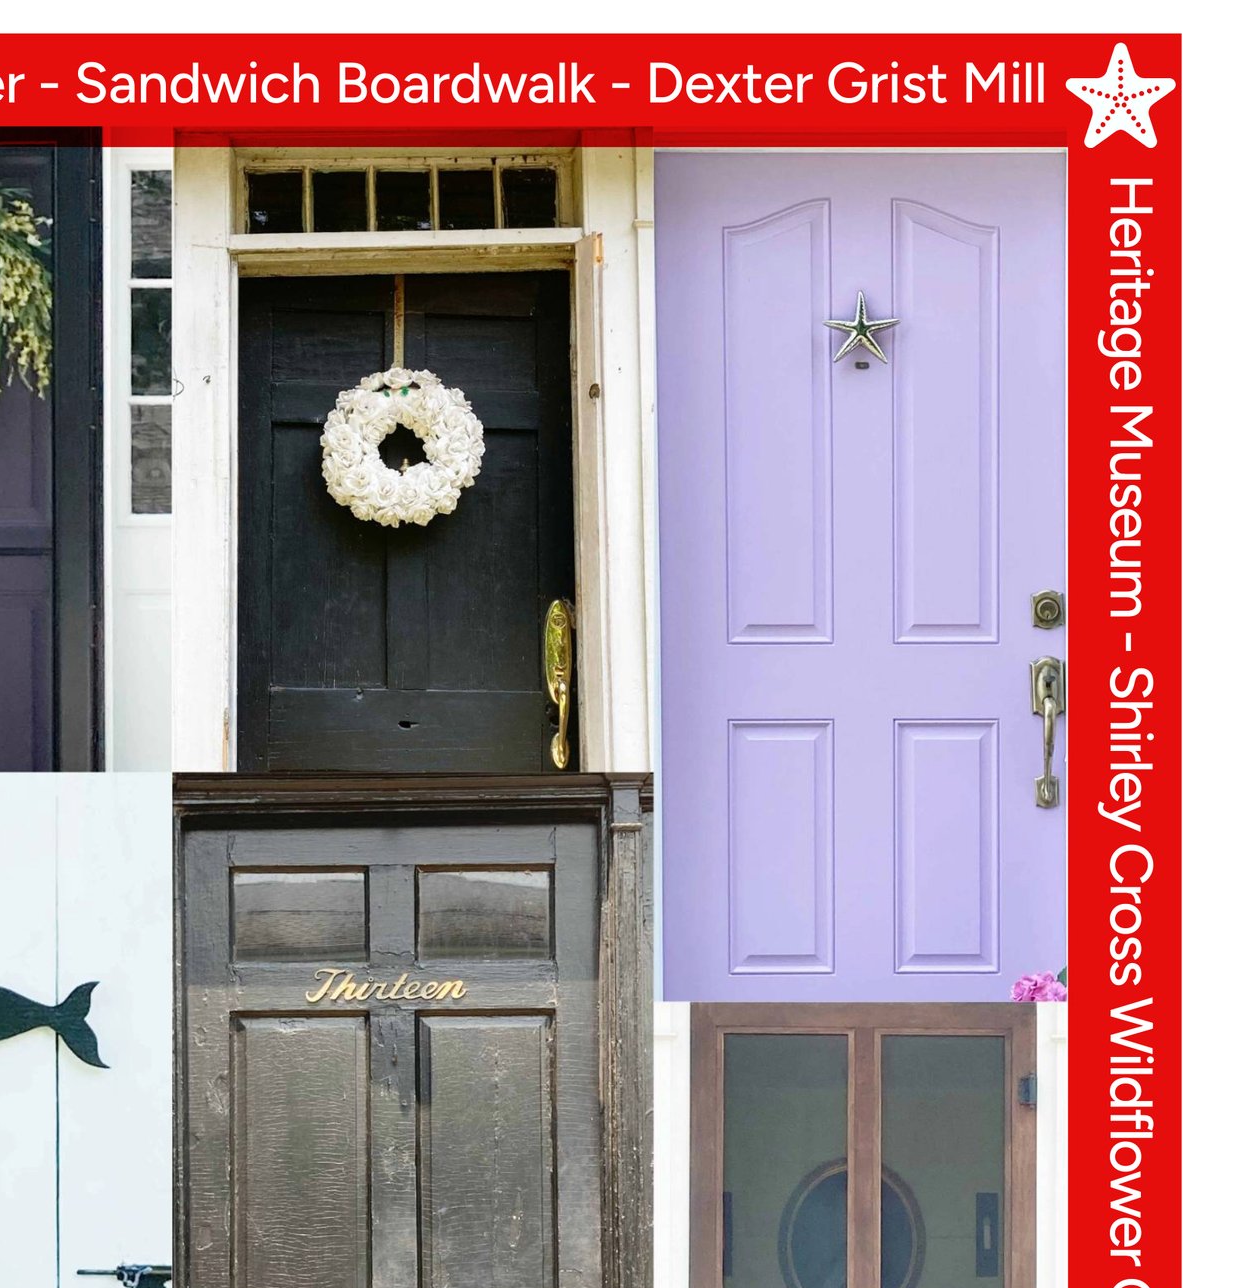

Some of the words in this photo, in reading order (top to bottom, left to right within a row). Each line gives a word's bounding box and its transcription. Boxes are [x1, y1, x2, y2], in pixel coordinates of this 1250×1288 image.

[76, 61, 320, 104] Sandwich
[339, 62, 596, 104] Boardwalk
[649, 62, 814, 104] Dexter
[827, 61, 948, 104] Grist
[965, 61, 1045, 103] Mill
[1097, 178, 1155, 391] Heritage
[1109, 405, 1154, 617] Museum
[1097, 666, 1155, 832] Shirley
[305, 968, 468, 1003] Thirteen
[1109, 844, 1154, 986] Cross
[1109, 997, 1155, 1267] Wildflower
